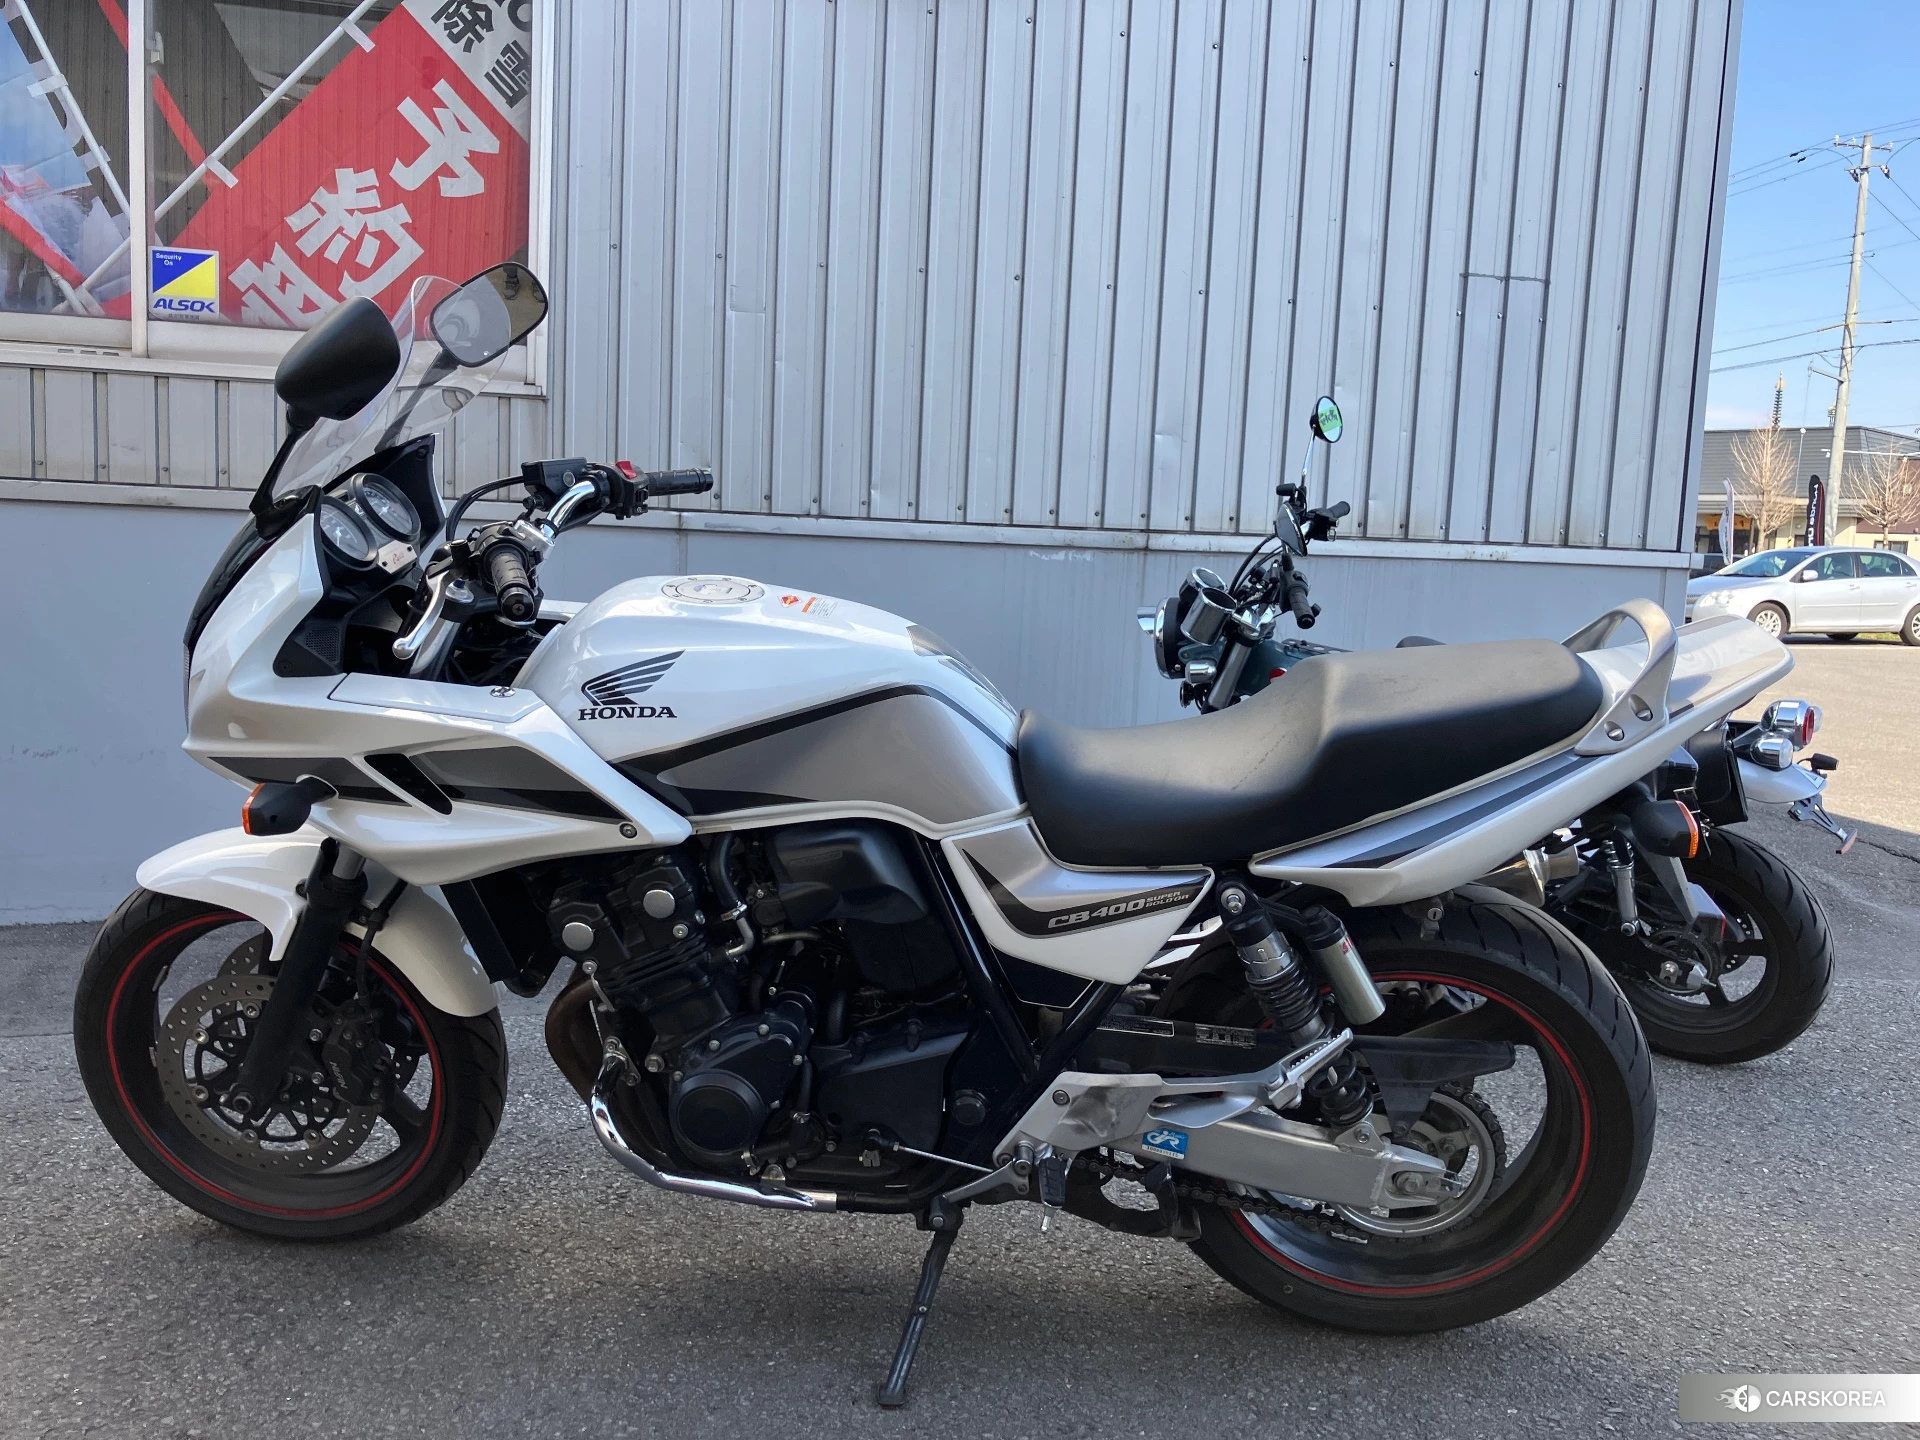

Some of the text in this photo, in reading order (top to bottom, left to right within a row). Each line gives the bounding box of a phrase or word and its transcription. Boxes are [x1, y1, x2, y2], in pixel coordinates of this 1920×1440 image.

[155, 252, 182, 261] Security
[153, 298, 215, 314] ALSOK
[577, 706, 678, 721] HONDA
[1048, 891, 1181, 929] CB400 SUPER
